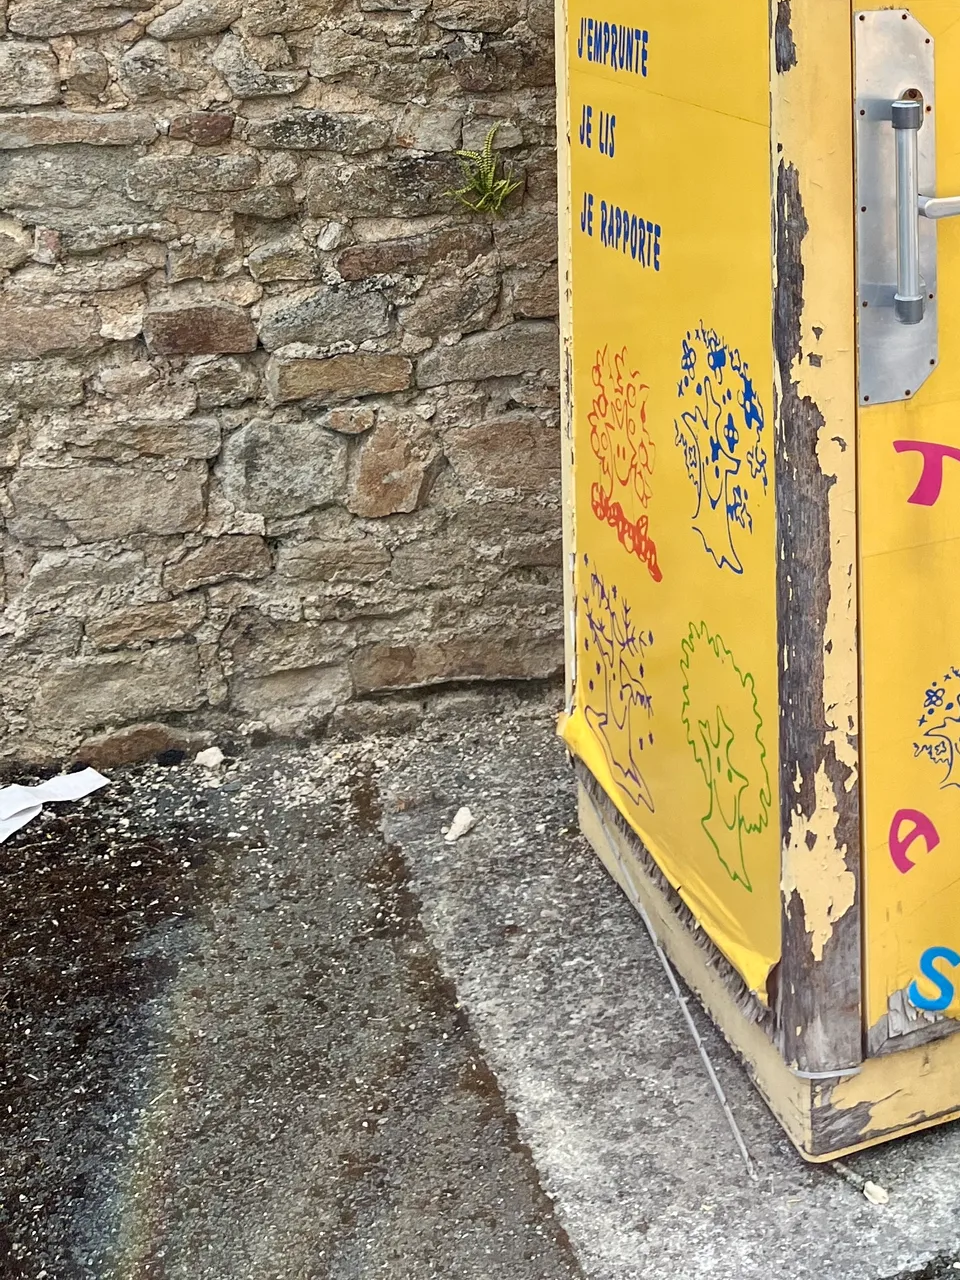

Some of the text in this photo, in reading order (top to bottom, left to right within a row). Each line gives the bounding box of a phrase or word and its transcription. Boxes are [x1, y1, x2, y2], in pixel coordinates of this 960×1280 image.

[578, 17, 649, 77] J'EMPRUNTE
[579, 104, 616, 158] JE LIS
[580, 191, 661, 272] JE RAPPORTE
[888, 807, 940, 874] A
